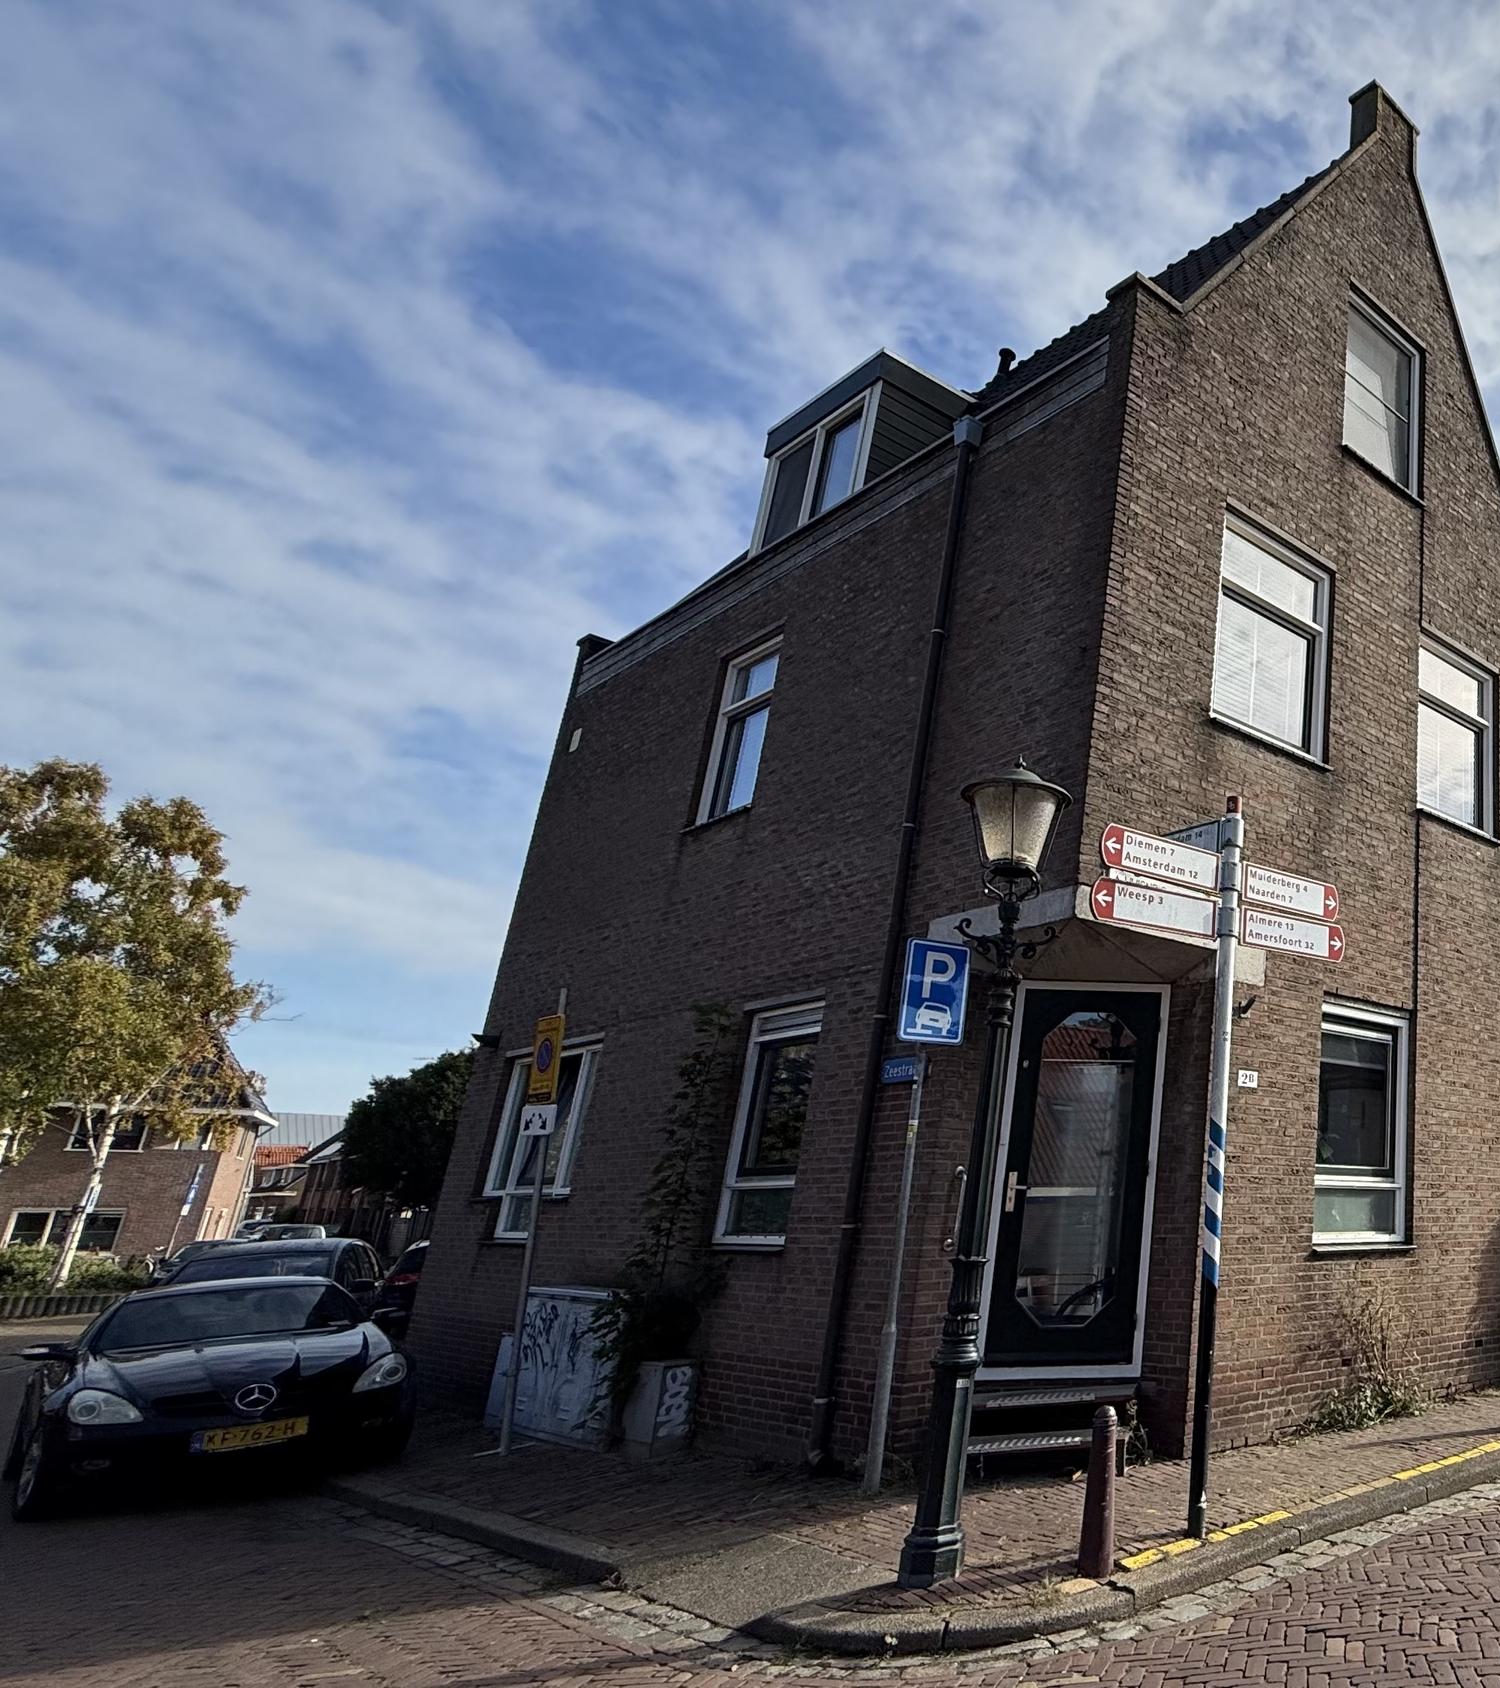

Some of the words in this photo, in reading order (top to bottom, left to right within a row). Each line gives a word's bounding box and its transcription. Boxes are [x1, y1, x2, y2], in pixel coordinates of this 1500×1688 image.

[1126, 835, 1168, 857] Diemen
[1170, 848, 1176, 857] 7
[1124, 851, 1186, 877] Amsterdam
[1188, 871, 1199, 880] 12
[1249, 869, 1301, 893] Muiderberg
[1302, 885, 1309, 893] 4
[1117, 886, 1155, 905] Weesp
[1158, 896, 1164, 905] 3
[1249, 884, 1287, 903] Naarden
[1288, 896, 1294, 904] 7
[1249, 913, 1283, 929] Almere
[1284, 923, 1295, 931] 13
[1247, 929, 1303, 948] Amersfoort
[1304, 941, 1315, 950] 32
[921, 951, 957, 999] P
